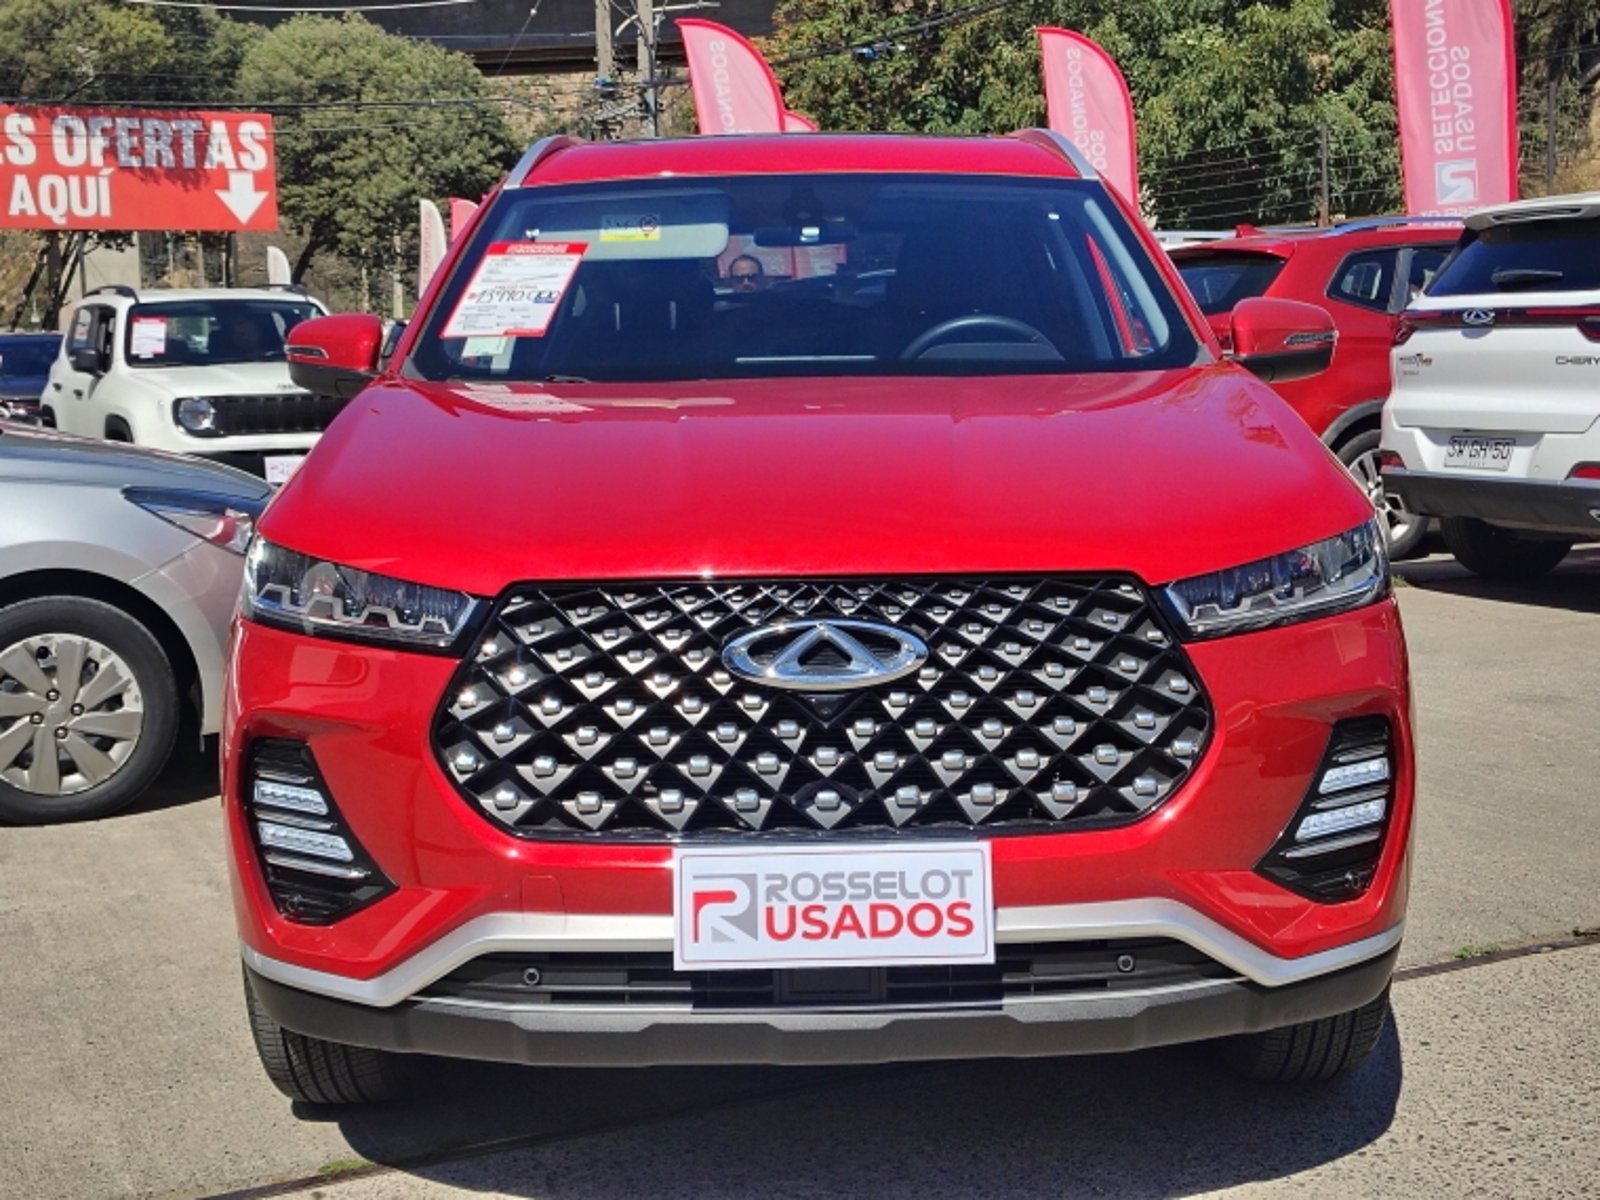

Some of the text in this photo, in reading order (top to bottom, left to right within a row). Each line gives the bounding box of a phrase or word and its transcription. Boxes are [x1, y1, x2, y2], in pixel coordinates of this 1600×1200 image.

[0, 112, 269, 172] S OFERTAS
[8, 167, 116, 225] AQUÍ
[764, 869, 973, 903] ROSSELOT
[765, 901, 974, 942] USADOS
